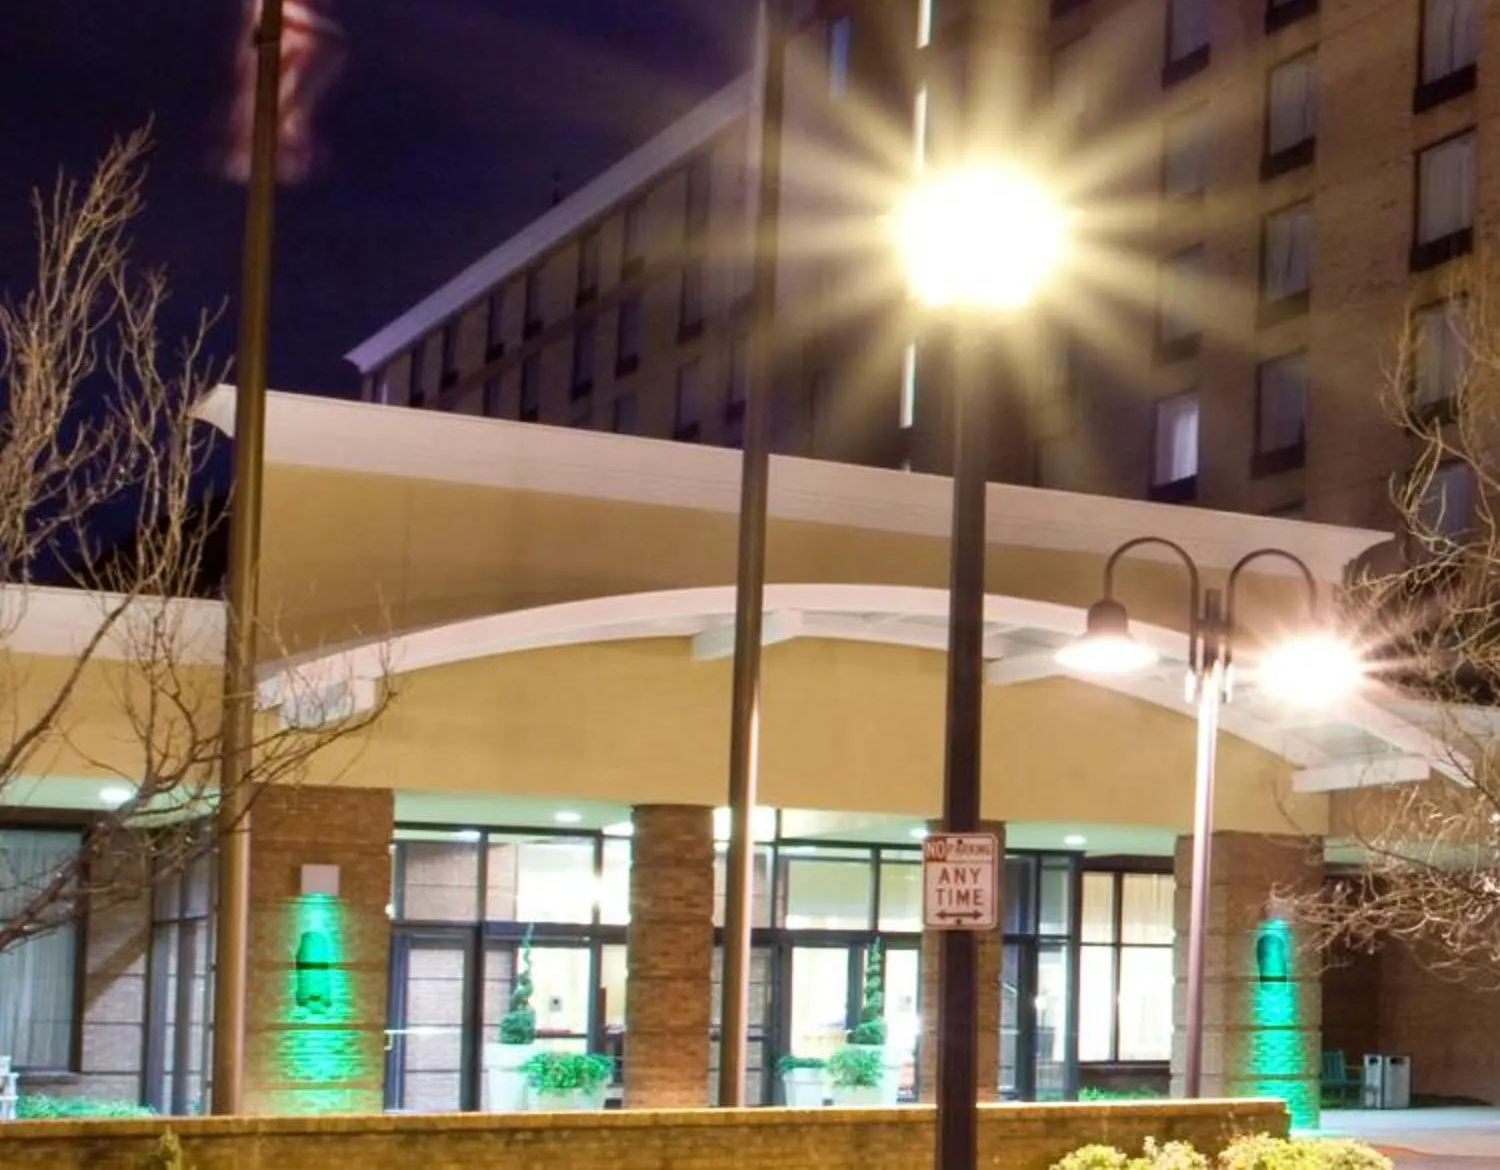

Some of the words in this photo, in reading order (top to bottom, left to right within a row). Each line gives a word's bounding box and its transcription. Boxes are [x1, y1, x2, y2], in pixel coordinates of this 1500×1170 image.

[925, 839, 946, 860] NO
[947, 843, 992, 855] PARKING
[938, 867, 982, 885] ANY
[935, 887, 985, 907] TIME
